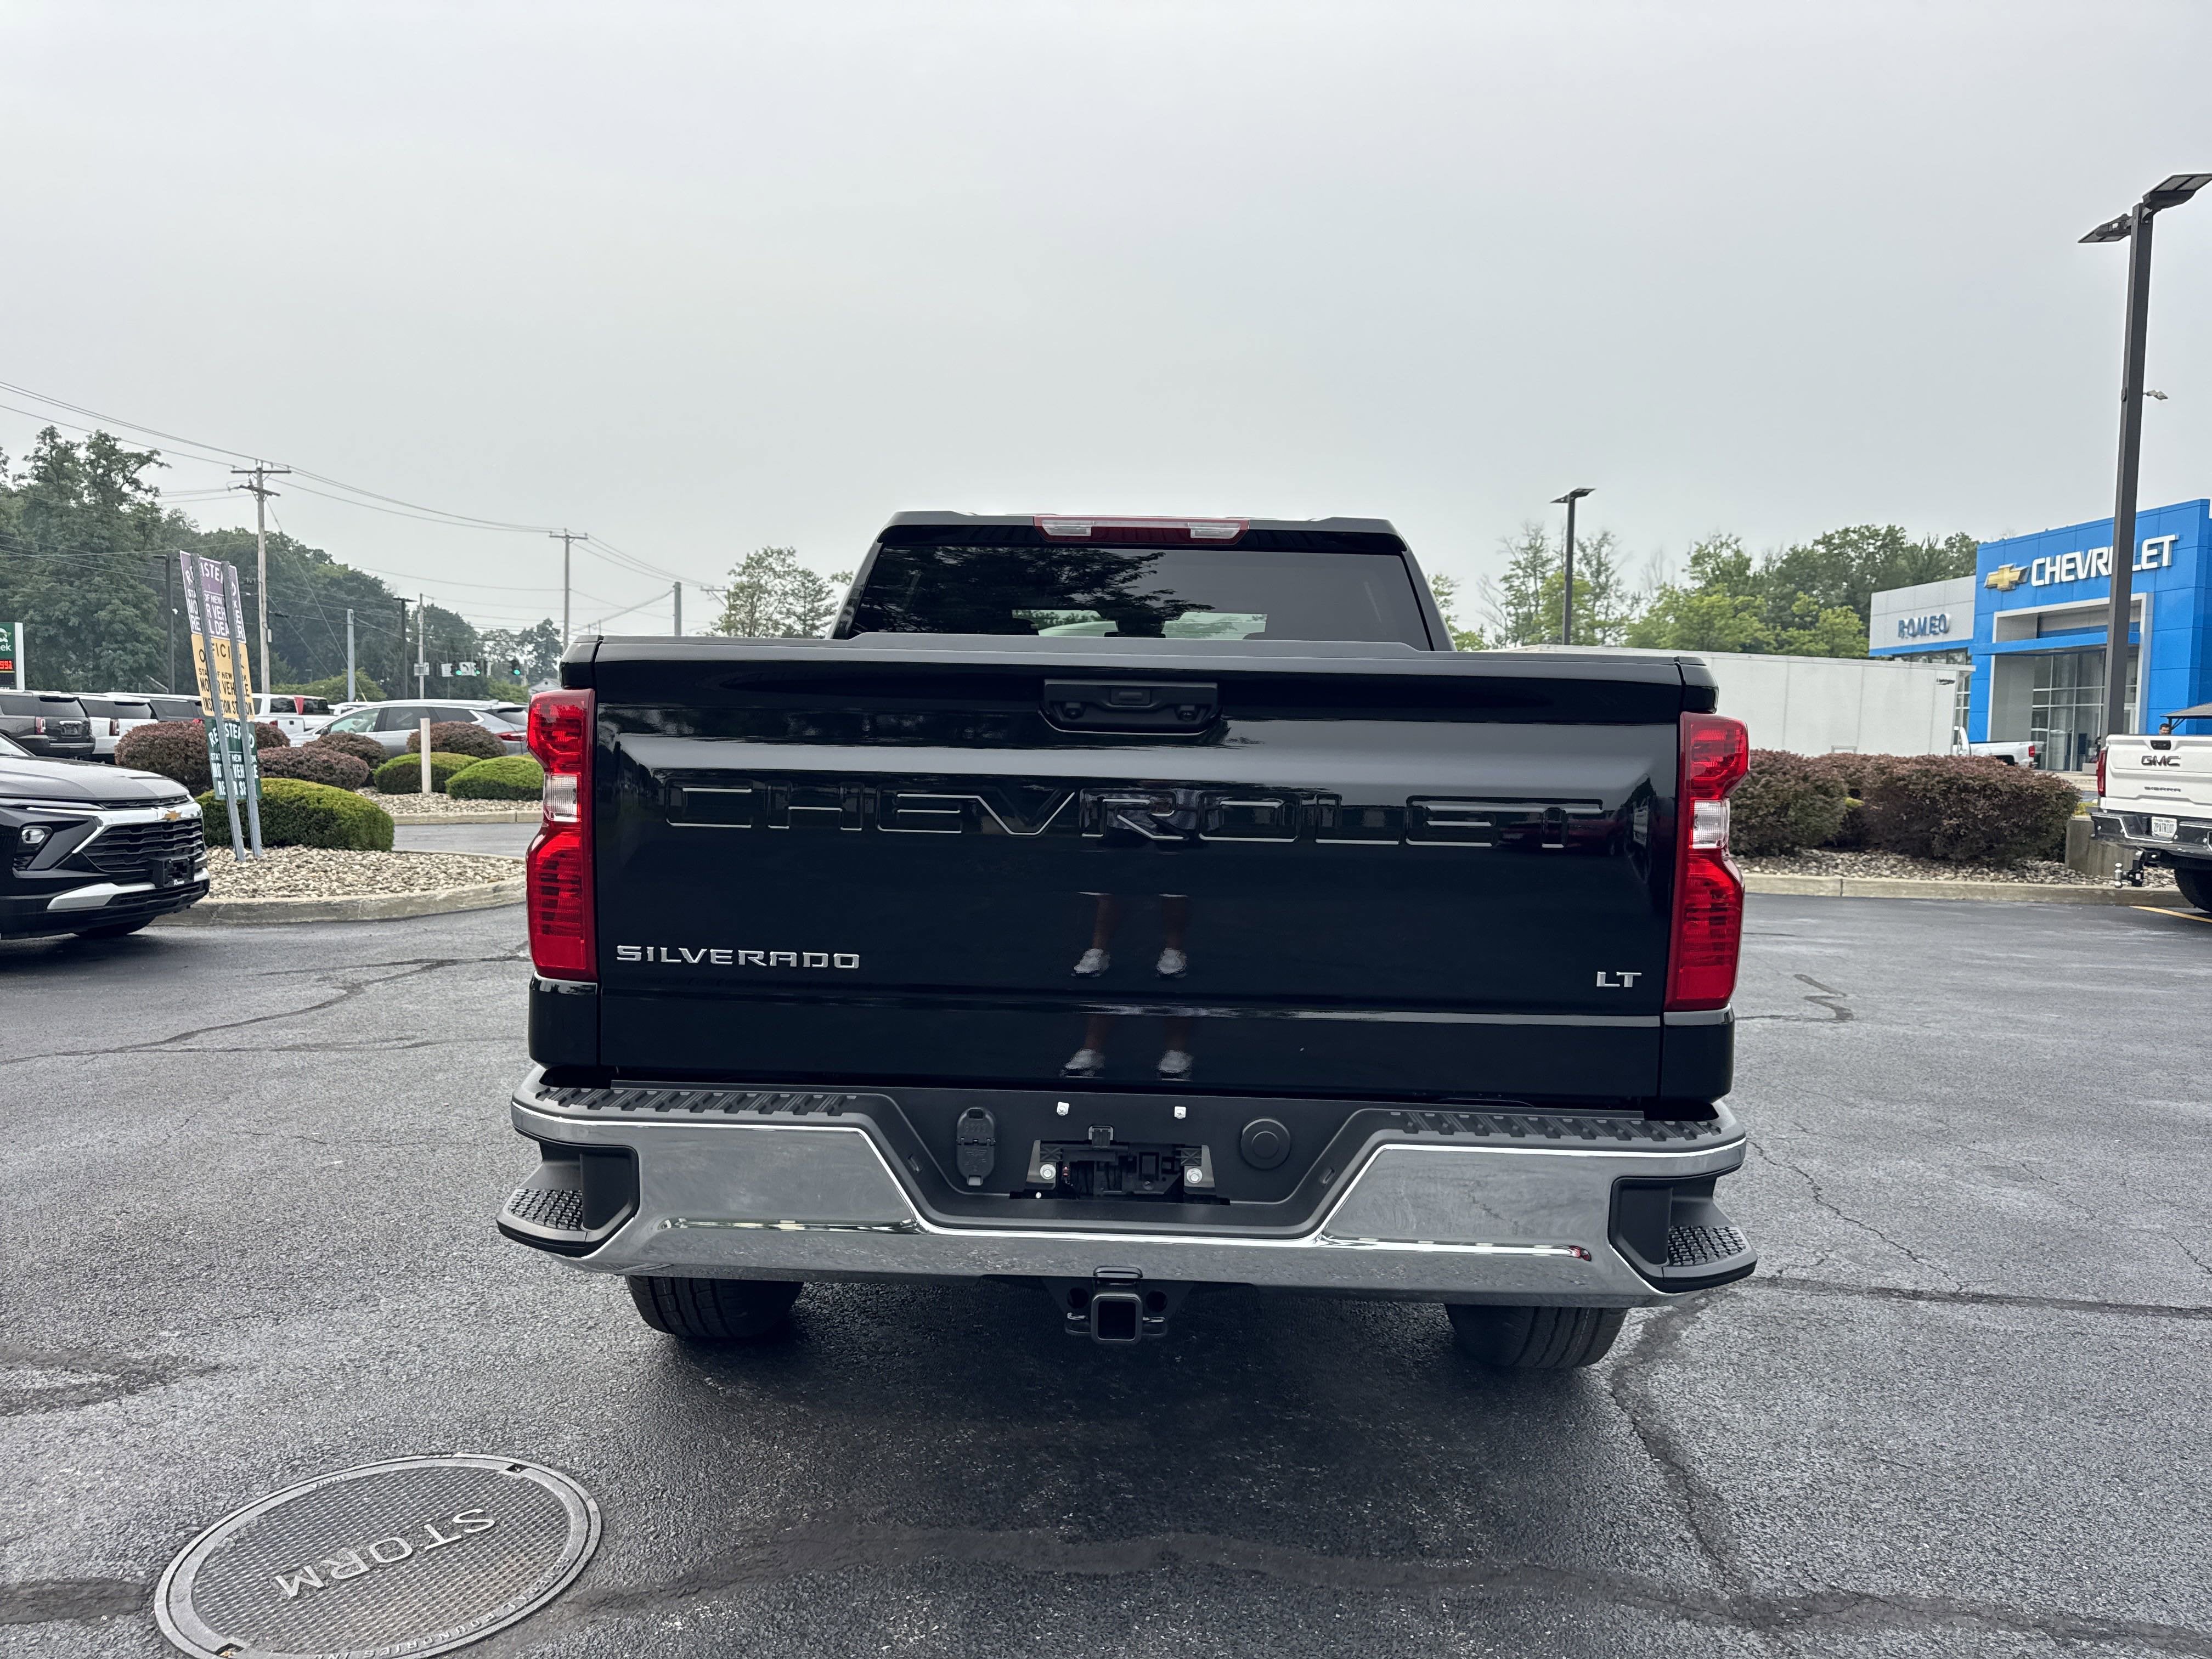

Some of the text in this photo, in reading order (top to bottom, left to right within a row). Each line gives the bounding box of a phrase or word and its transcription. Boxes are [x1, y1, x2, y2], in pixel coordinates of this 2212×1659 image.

[185, 562, 236, 596] RISTED
[187, 599, 212, 618] MOR
[212, 605, 242, 624] VEHE
[211, 595, 223, 605] NEW
[190, 615, 244, 640] REL DEAR
[1898, 614, 1949, 639] ROMEO
[222, 672, 232, 680] NEW
[222, 680, 250, 697] VEHE
[202, 697, 253, 716] INSION STON
[208, 723, 255, 748] RESTED
[232, 754, 242, 762] NEW
[2142, 755, 2181, 766] GMC
[233, 764, 258, 778] VEHE
[664, 777, 1603, 849] CHEVROLET
[617, 945, 860, 969] SILVERADO
[1596, 972, 1642, 988] LT
[275, 1509, 495, 1599] STORM
[362, 1609, 495, 1658] FOUNDRIES
